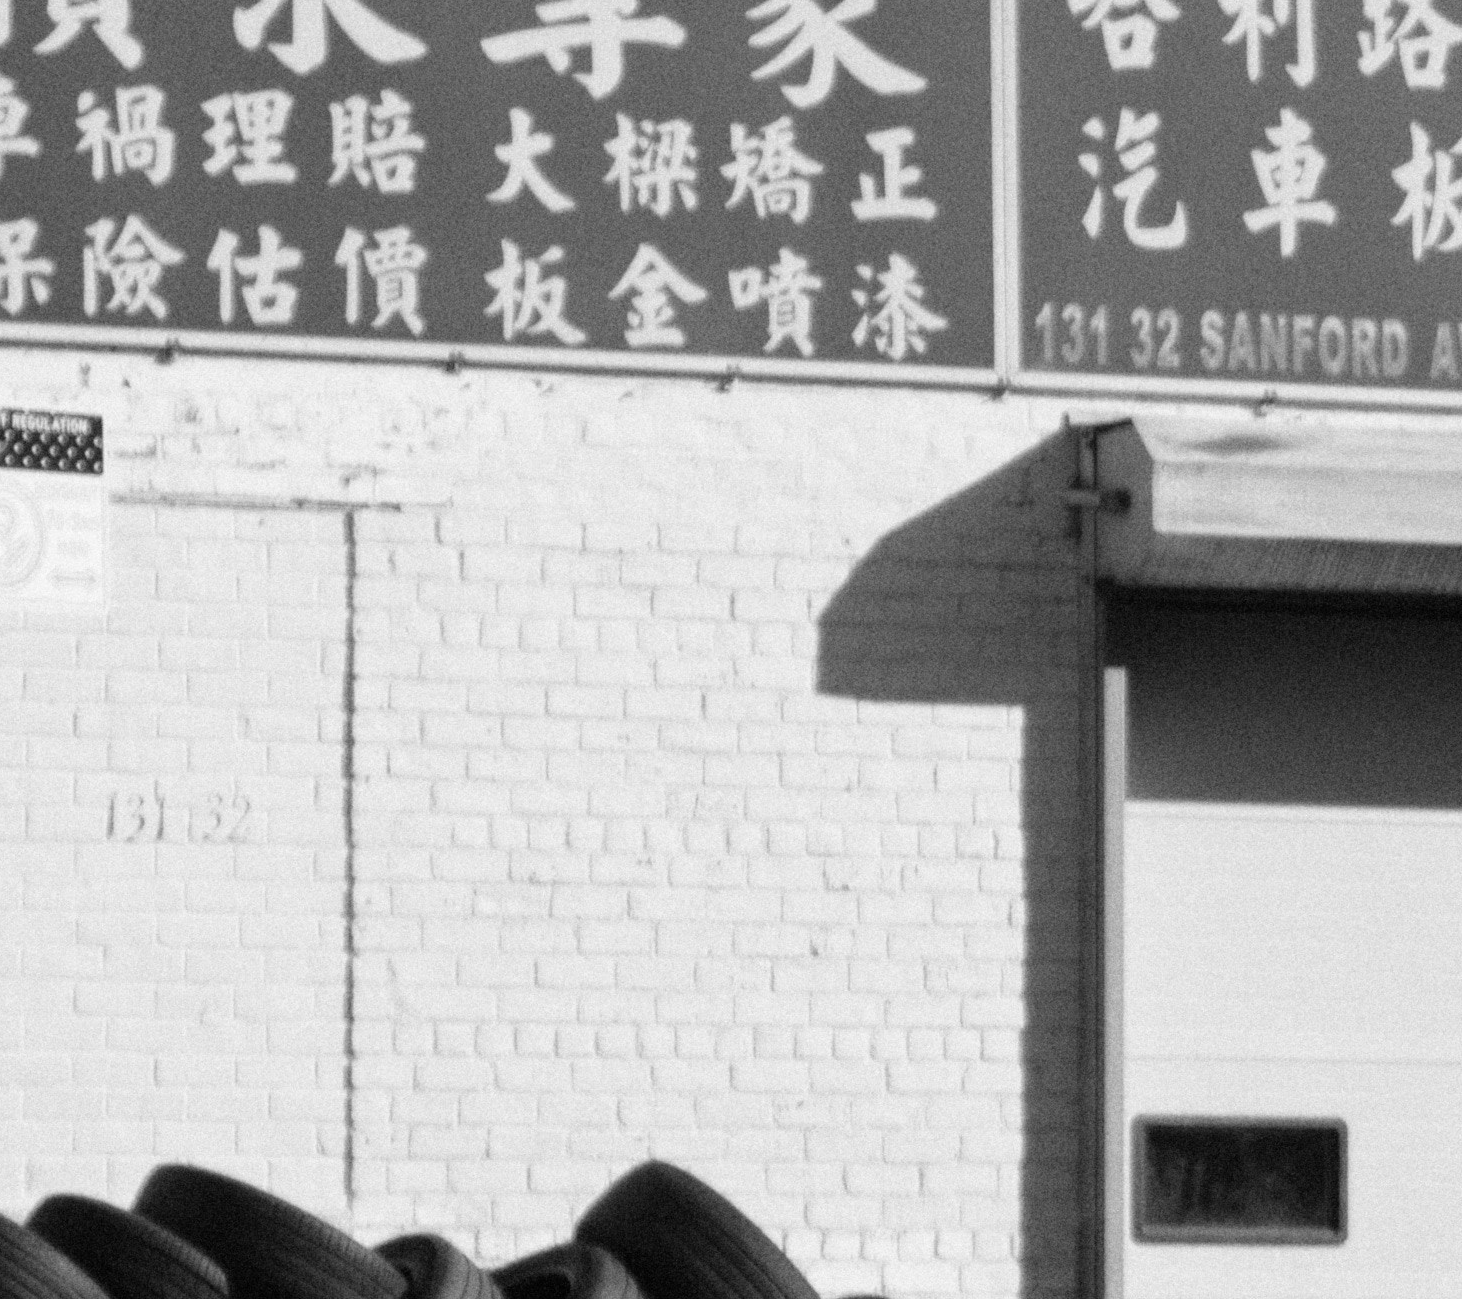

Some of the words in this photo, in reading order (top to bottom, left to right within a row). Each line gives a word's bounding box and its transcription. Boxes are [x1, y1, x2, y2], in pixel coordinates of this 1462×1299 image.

[1035, 301, 1109, 367] 131
[1130, 306, 1182, 369] 32
[1199, 309, 1410, 379] SANFORD
[12, 412, 92, 436] REGULATION
